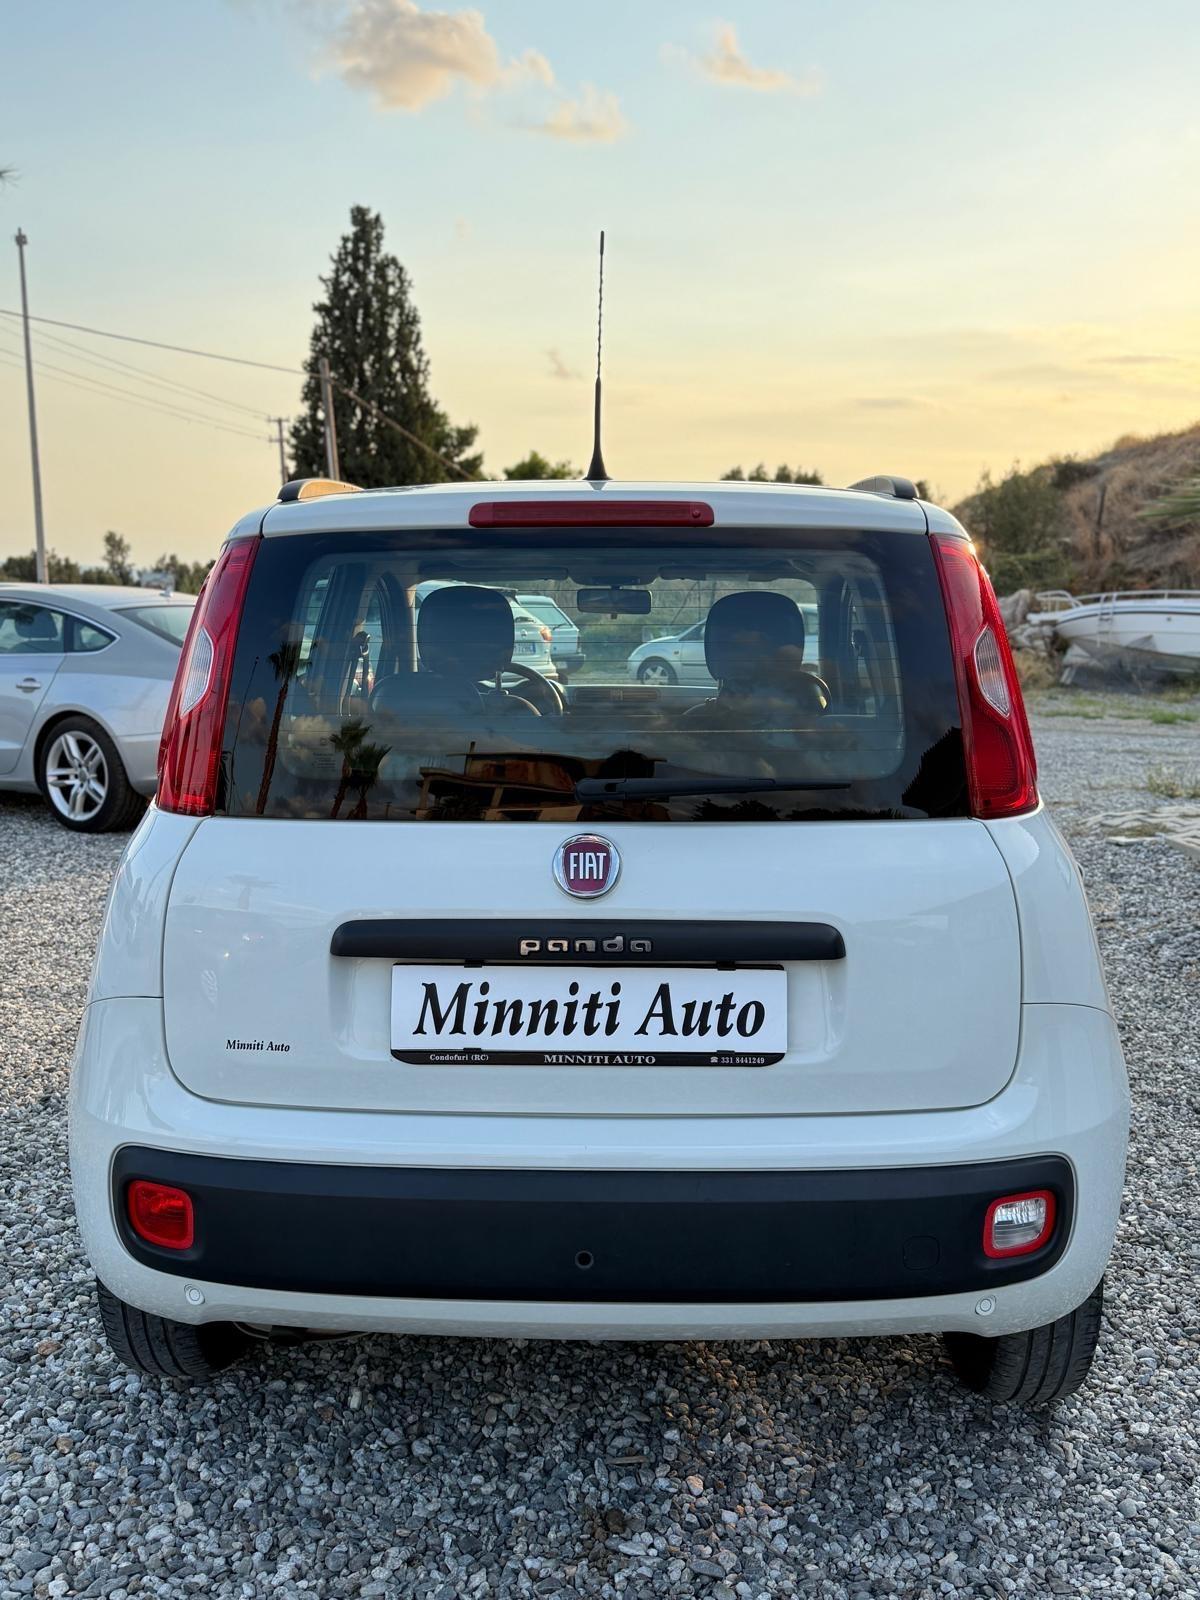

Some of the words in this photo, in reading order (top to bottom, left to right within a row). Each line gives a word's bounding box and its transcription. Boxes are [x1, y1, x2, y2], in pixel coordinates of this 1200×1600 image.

[569, 852, 607, 880] FIAT
[520, 935, 652, 956] panda
[412, 981, 622, 1037] Minniti
[634, 982, 766, 1038] Auto
[225, 1039, 264, 1051] Minniti
[266, 1041, 290, 1053] Auto
[429, 1053, 469, 1061] Condofuri
[471, 1053, 489, 1061] (RC)
[543, 1053, 610, 1065] MINNITI
[612, 1054, 656, 1065] AUTO
[720, 1056, 733, 1064] 331
[735, 1056, 765, 1064] 8441249
